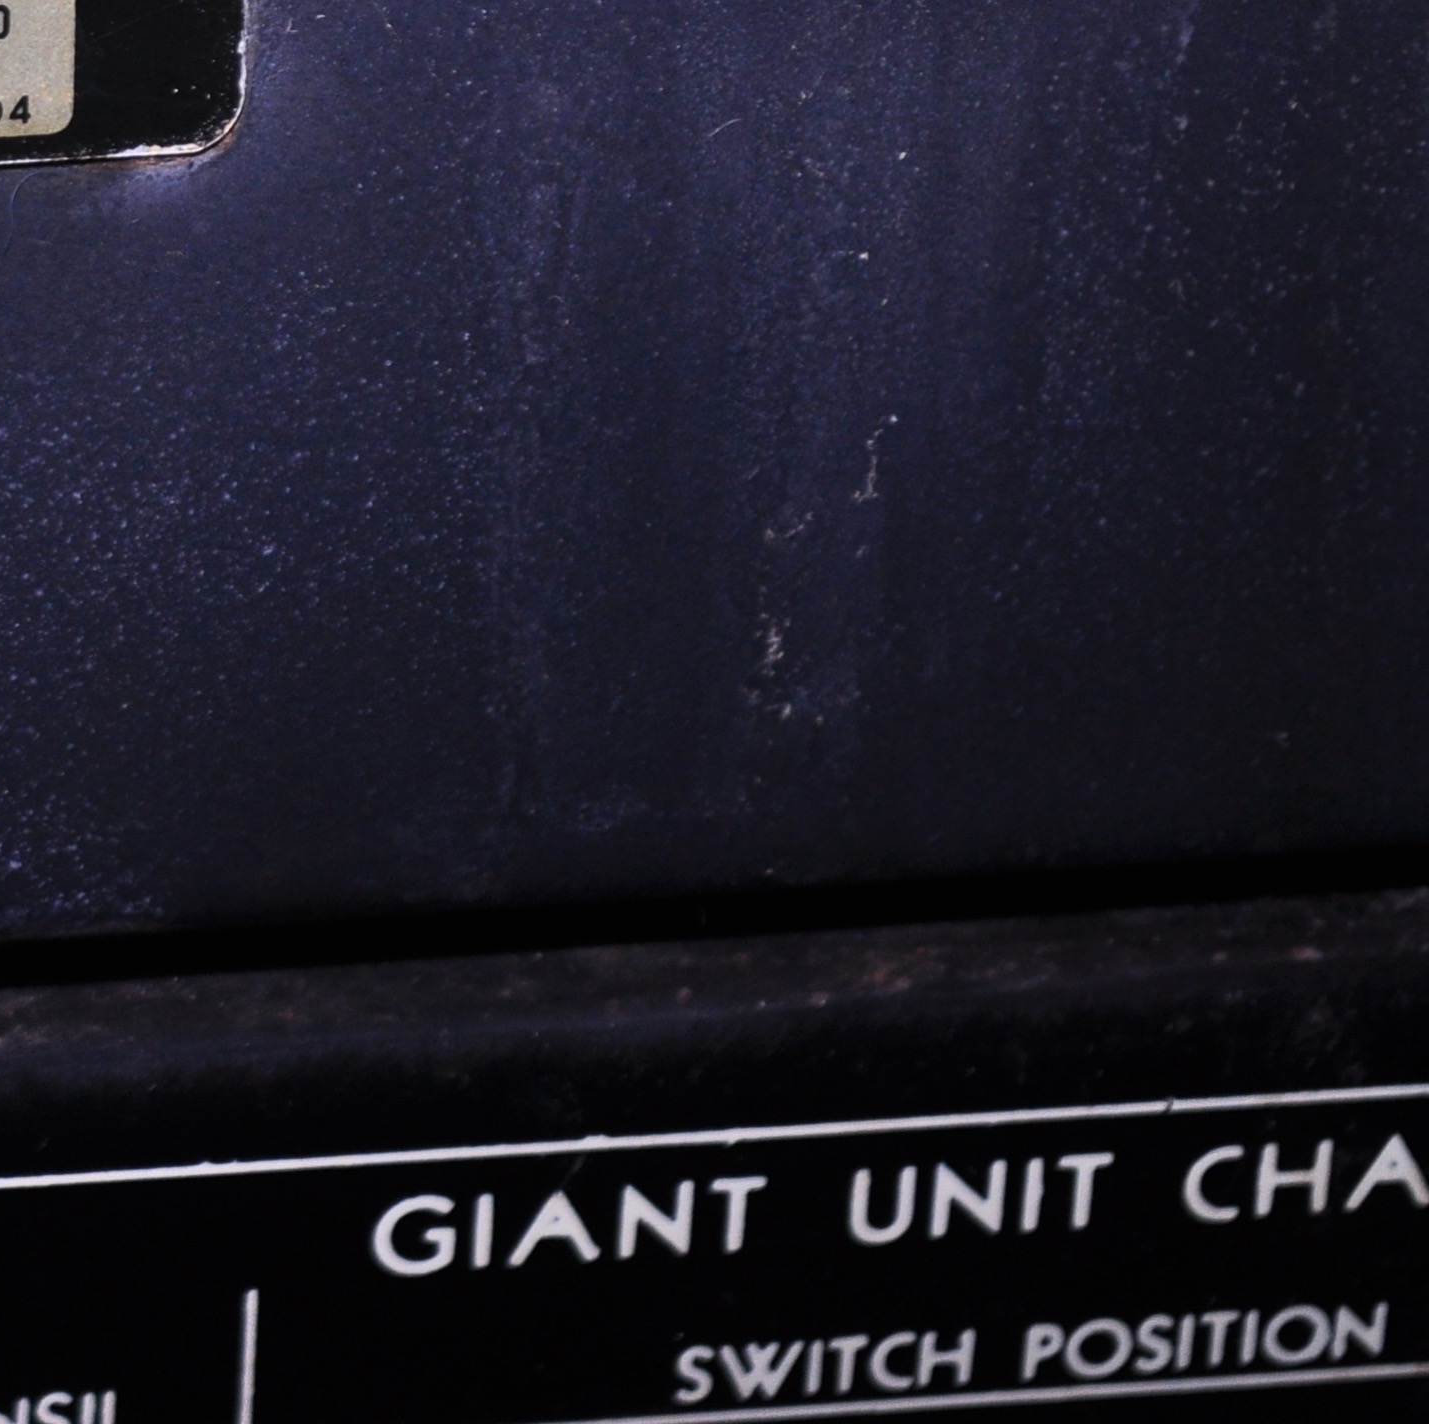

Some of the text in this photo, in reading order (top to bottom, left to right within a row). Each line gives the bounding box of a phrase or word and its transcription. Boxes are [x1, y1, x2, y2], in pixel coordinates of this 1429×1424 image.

[371, 1133, 1429, 1278] GIANT UNIT CHA
[672, 1300, 1390, 1405] SWITCH POSITION
